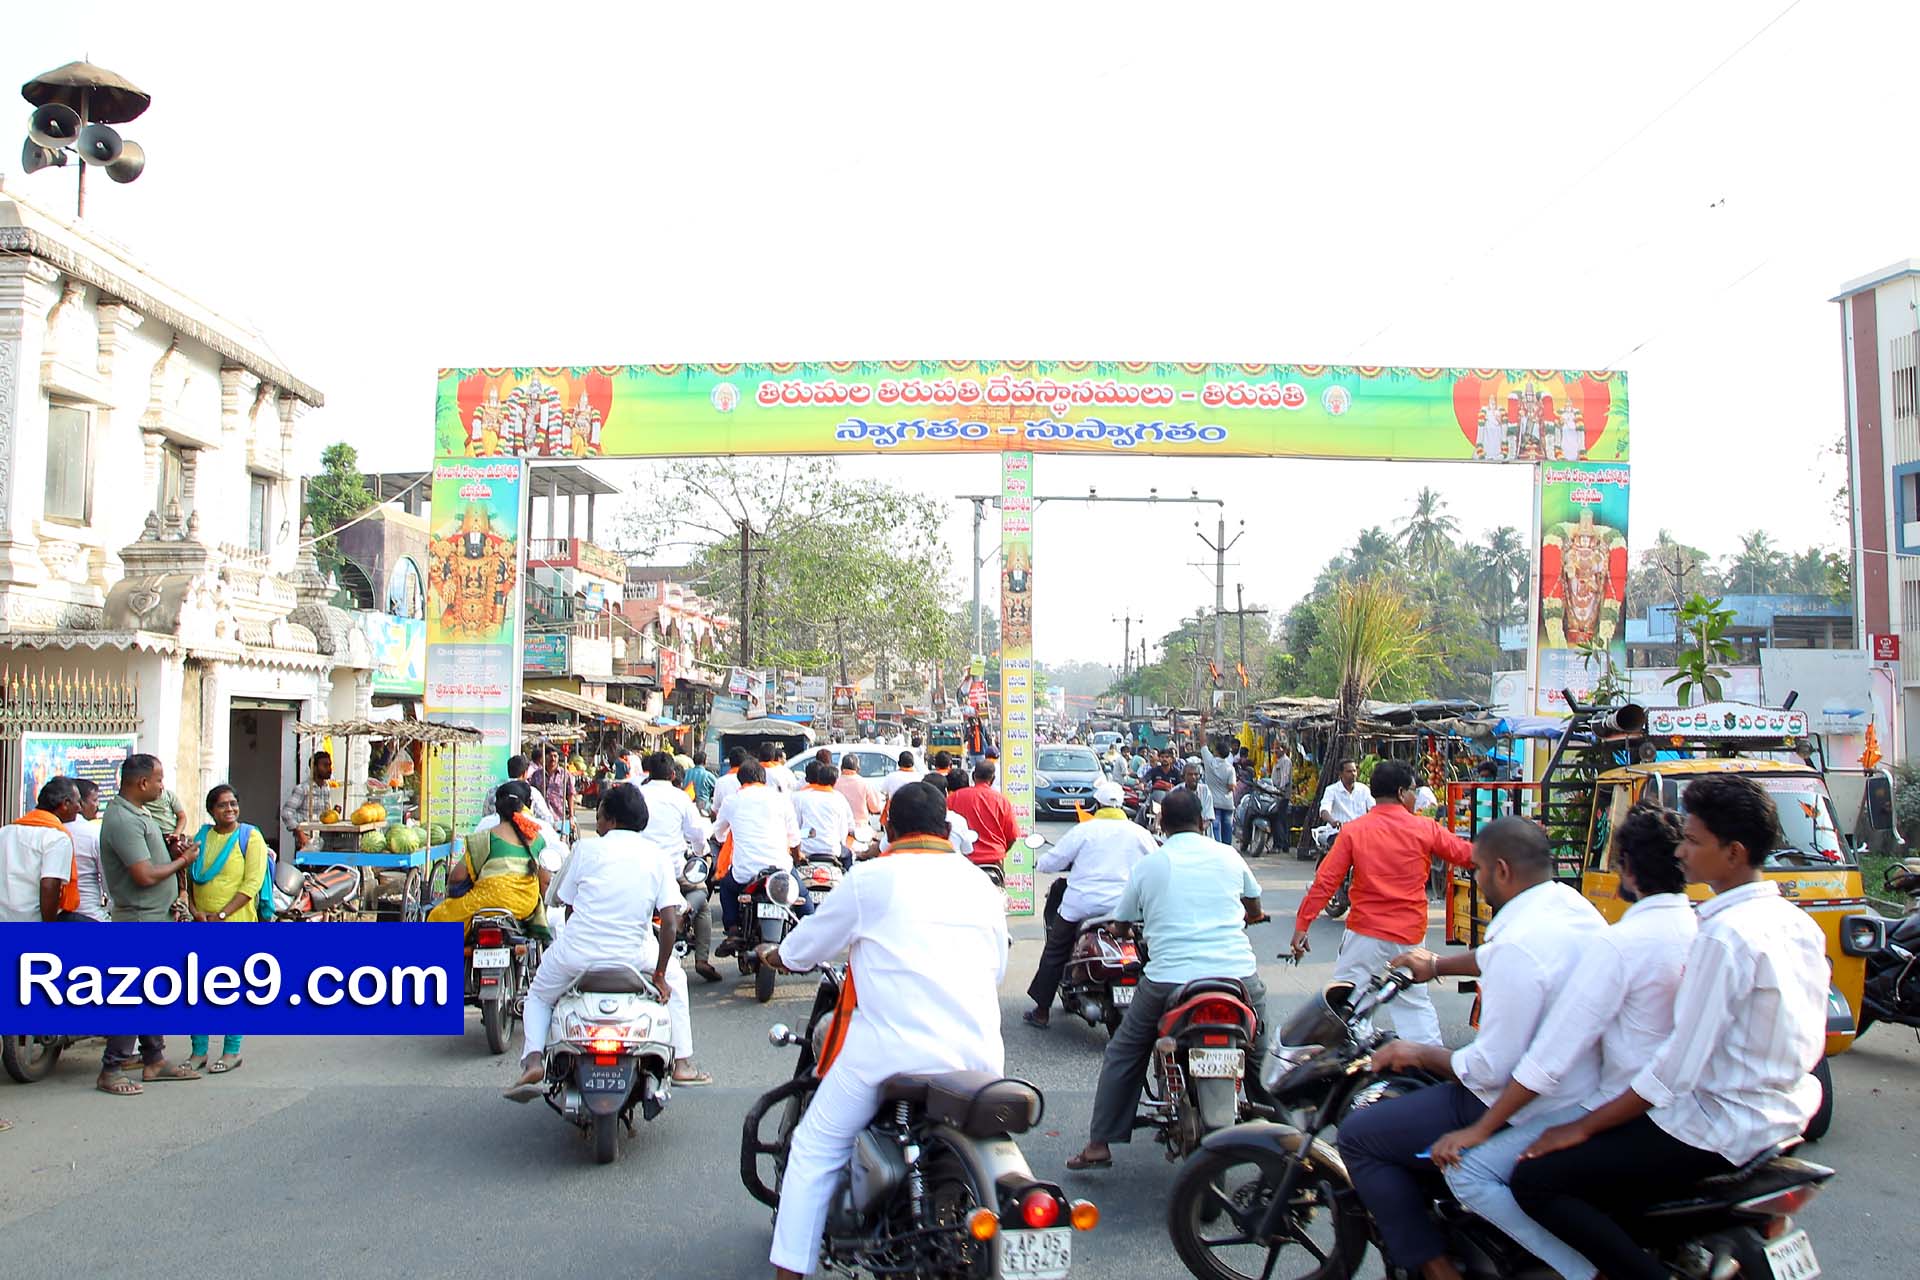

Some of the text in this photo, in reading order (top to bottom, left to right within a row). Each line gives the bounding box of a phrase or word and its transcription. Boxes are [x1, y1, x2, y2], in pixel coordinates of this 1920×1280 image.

[758, 381, 870, 404] తిరుమల
[877, 381, 981, 403] తిరుపతి
[986, 375, 1174, 415] దేవస్థానములు
[1202, 382, 1305, 408] తిరుపతి
[836, 418, 989, 446] స్వాగతం
[1026, 418, 1227, 446] సుస్వాగతం
